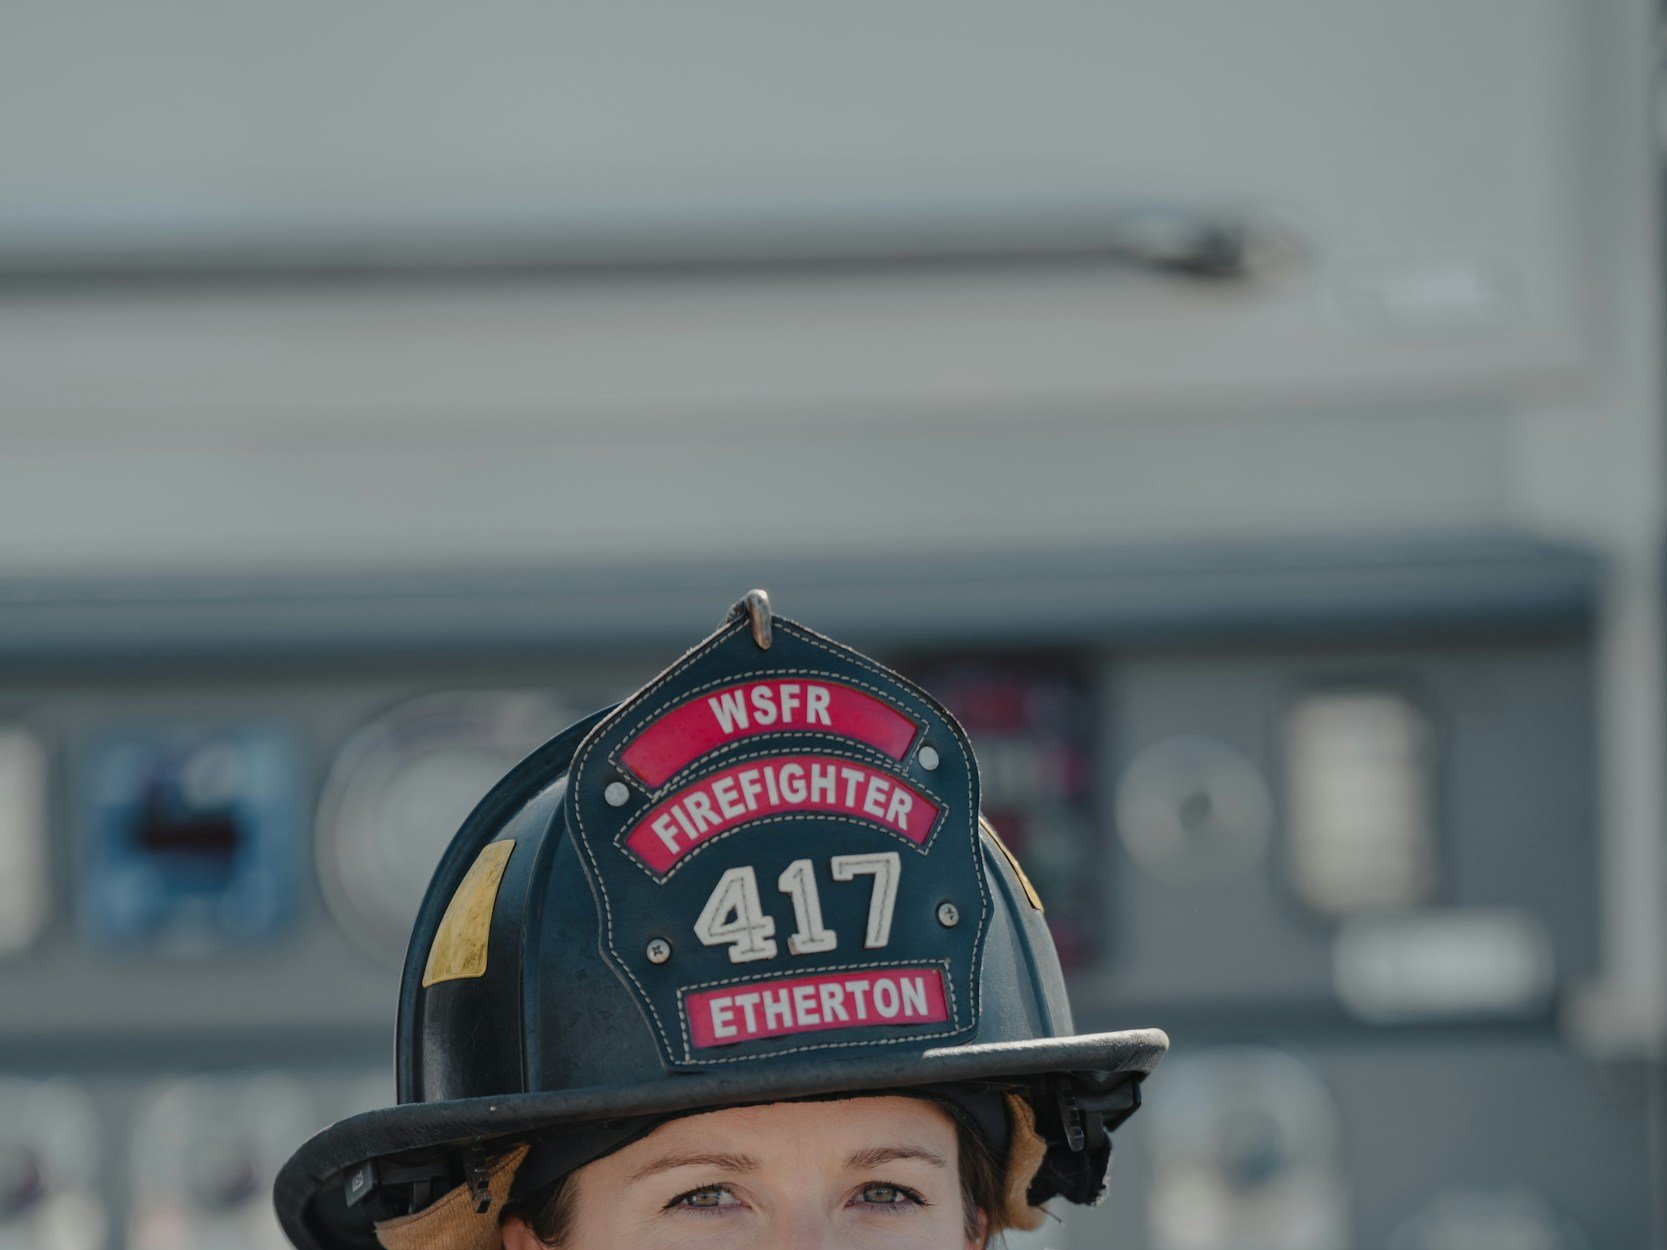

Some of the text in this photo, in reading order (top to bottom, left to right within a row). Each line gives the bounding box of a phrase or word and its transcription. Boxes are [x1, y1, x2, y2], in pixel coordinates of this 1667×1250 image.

[708, 683, 832, 735] WSFR
[650, 762, 914, 855] FIREFIGHTER
[694, 851, 901, 963] 417
[709, 976, 928, 1038] ETHERTON
